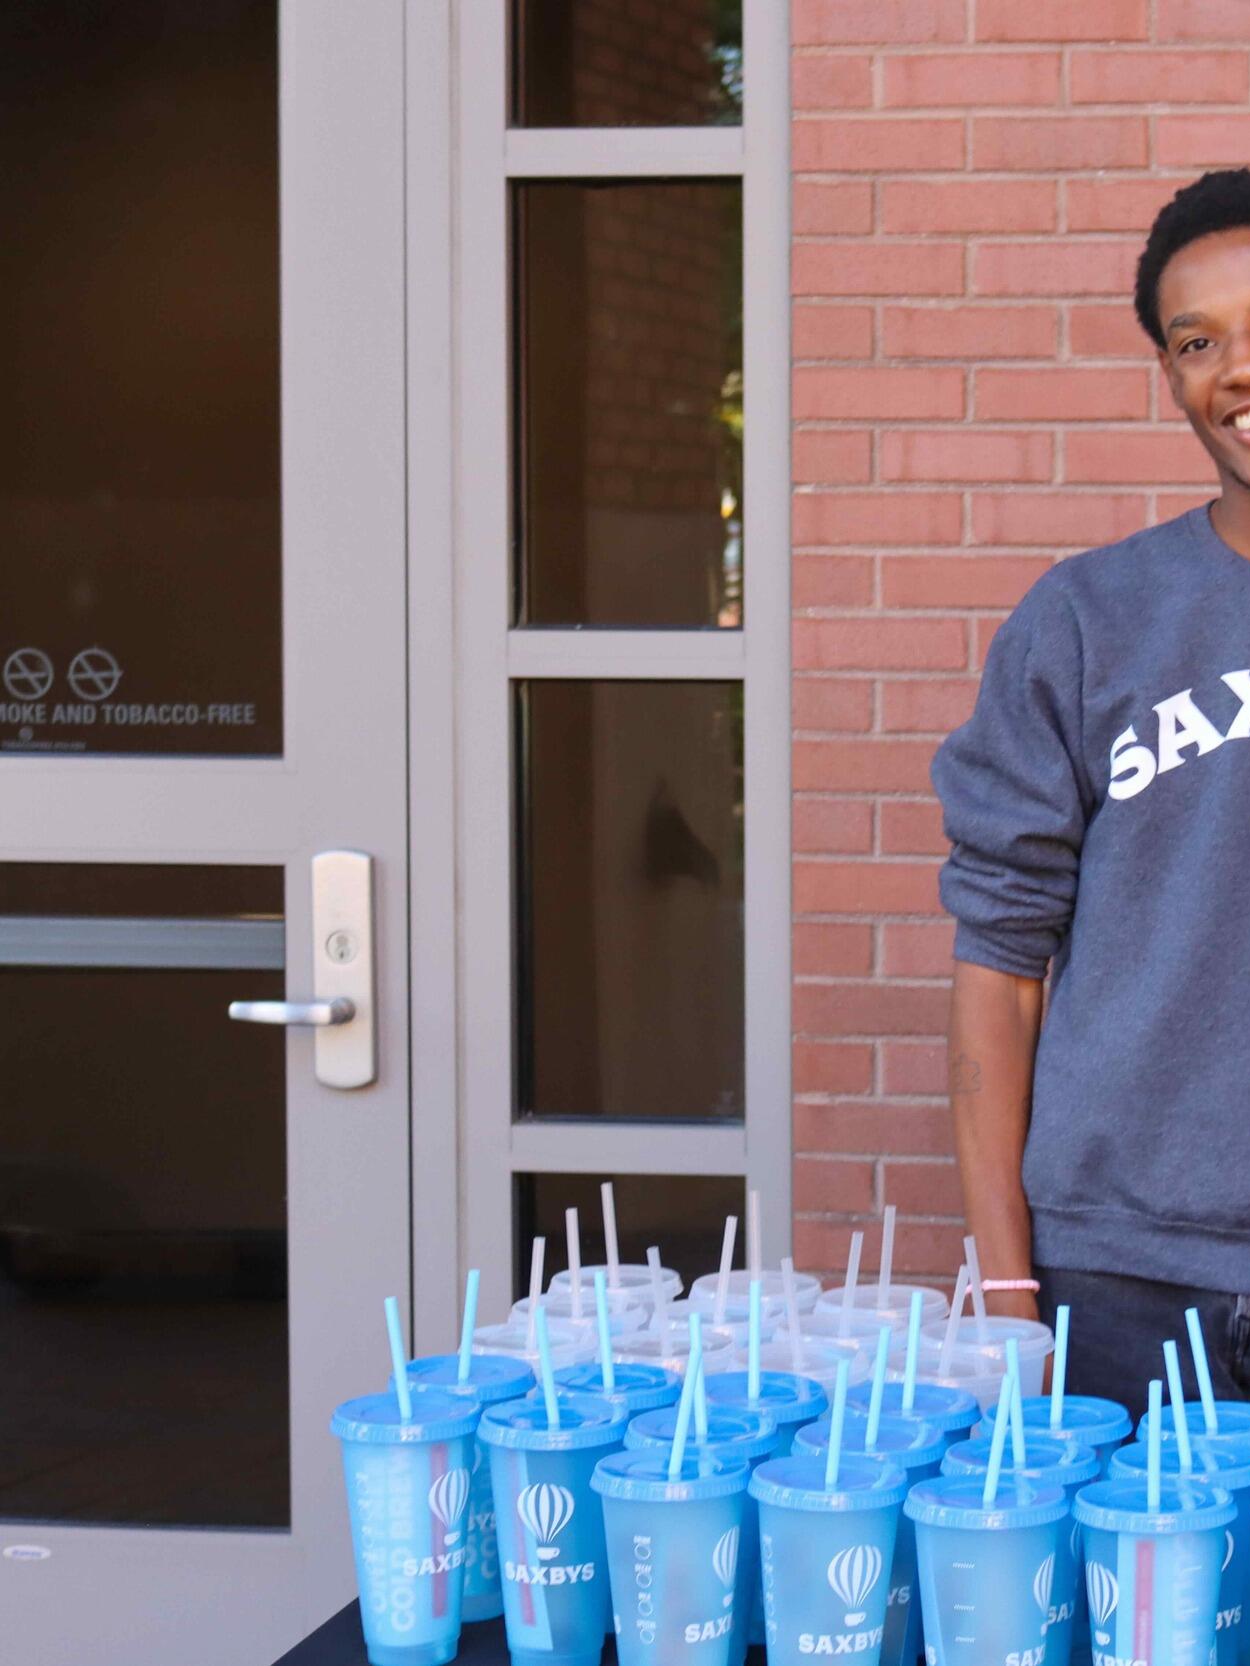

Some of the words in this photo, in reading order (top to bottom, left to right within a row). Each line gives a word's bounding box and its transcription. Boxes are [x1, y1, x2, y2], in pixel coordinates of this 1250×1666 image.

[52, 704, 97, 725] AND
[103, 704, 256, 725] TOBACCO-FREE
[504, 1561, 596, 1586] SAXBYS
